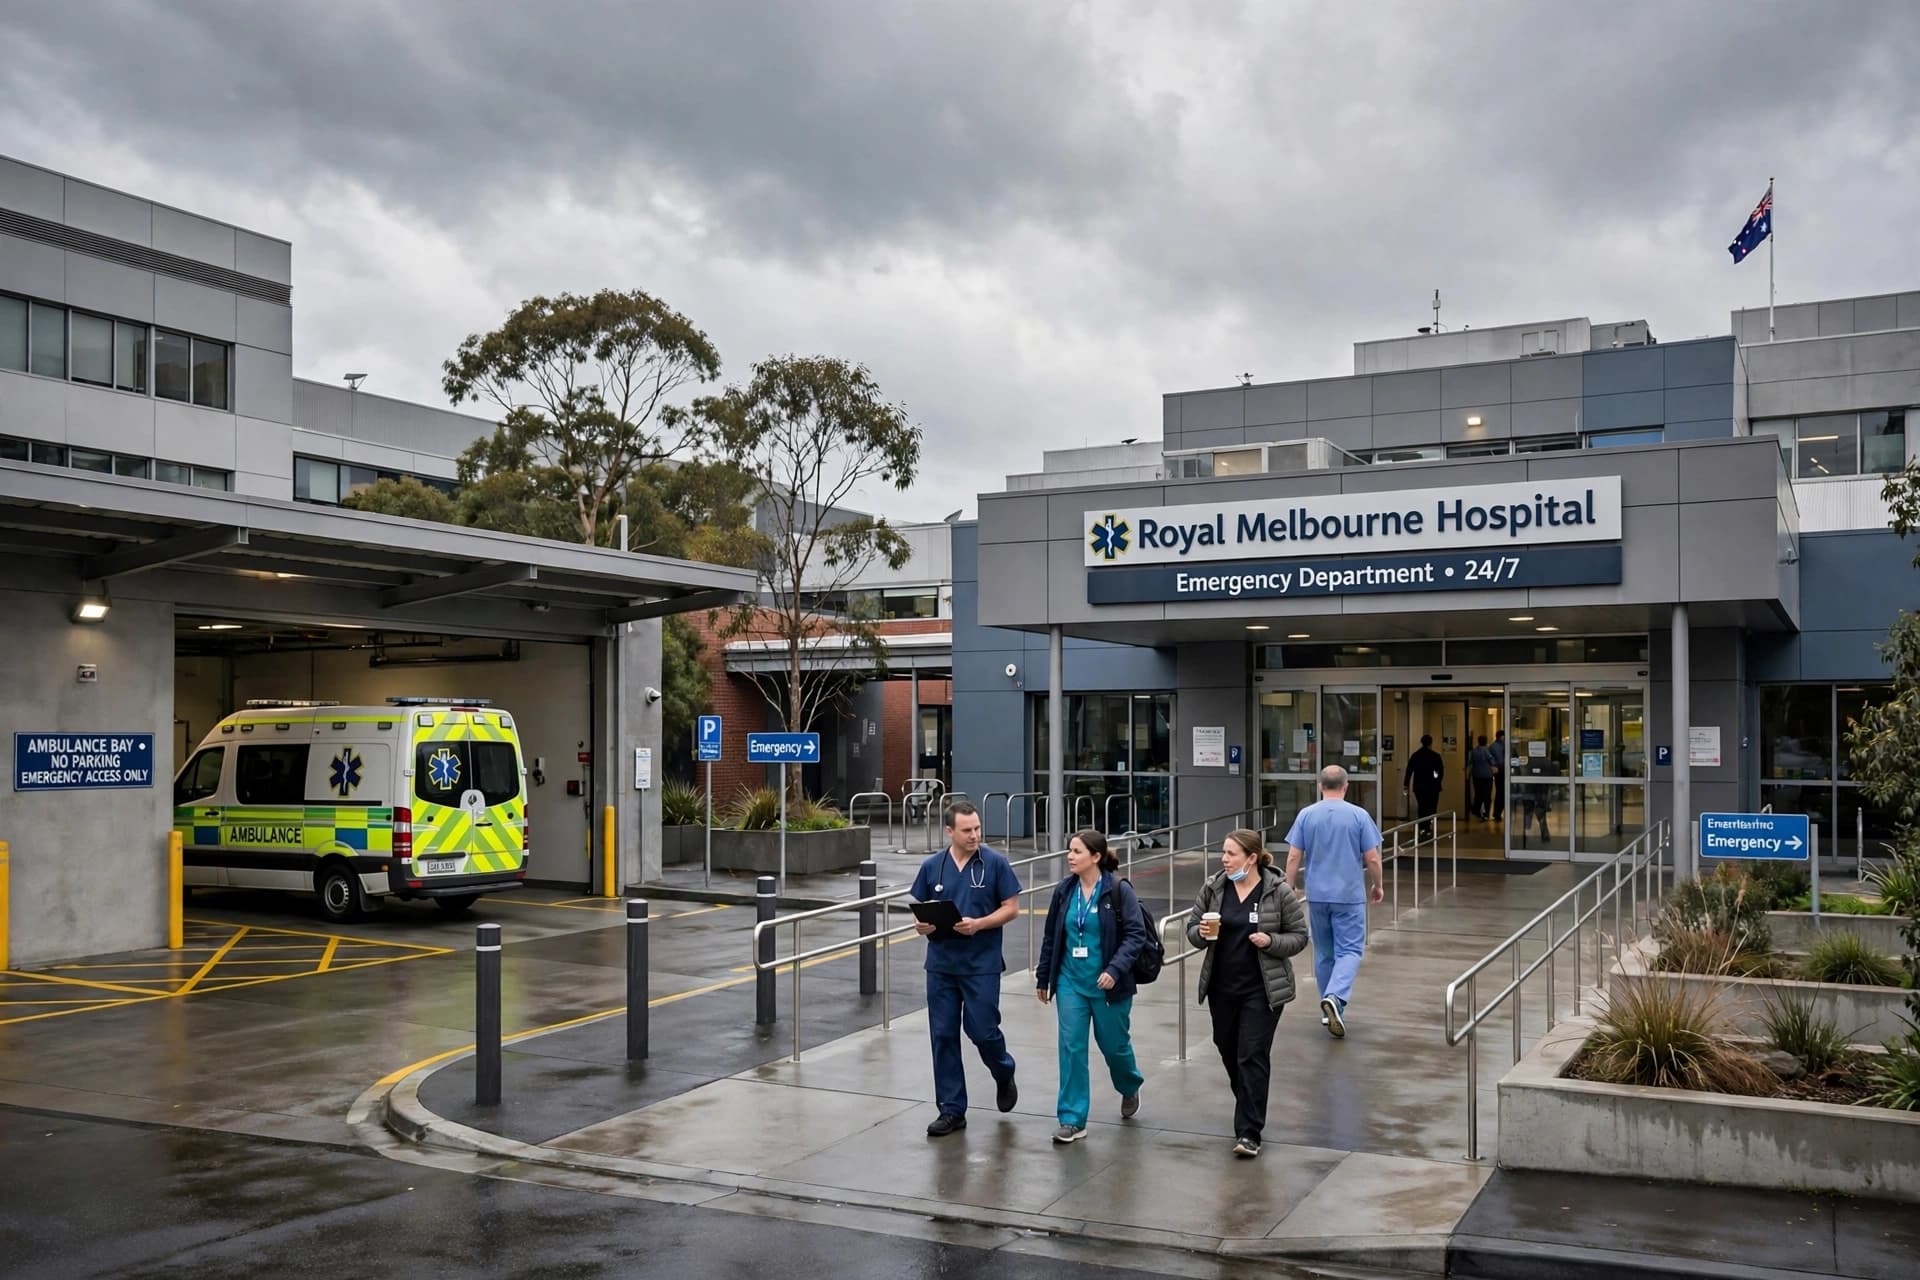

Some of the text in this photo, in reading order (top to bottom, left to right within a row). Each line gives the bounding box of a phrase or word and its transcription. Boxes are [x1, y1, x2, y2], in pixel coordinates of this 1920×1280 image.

[1138, 489, 1596, 555] Royal Melbourne Hospital
[1176, 557, 1520, 596] Emergency Department 24/7
[703, 719, 716, 741] P
[27, 738, 134, 753] AMBULANCE BAY
[750, 740, 802, 757] Emergency
[1659, 747, 1668, 760] P
[51, 753, 121, 769] NO PARKING
[21, 768, 149, 784] EMERGENCY ACCESS ONLY
[230, 826, 302, 844] AMBULANCE
[1707, 833, 1781, 852] Emergency
